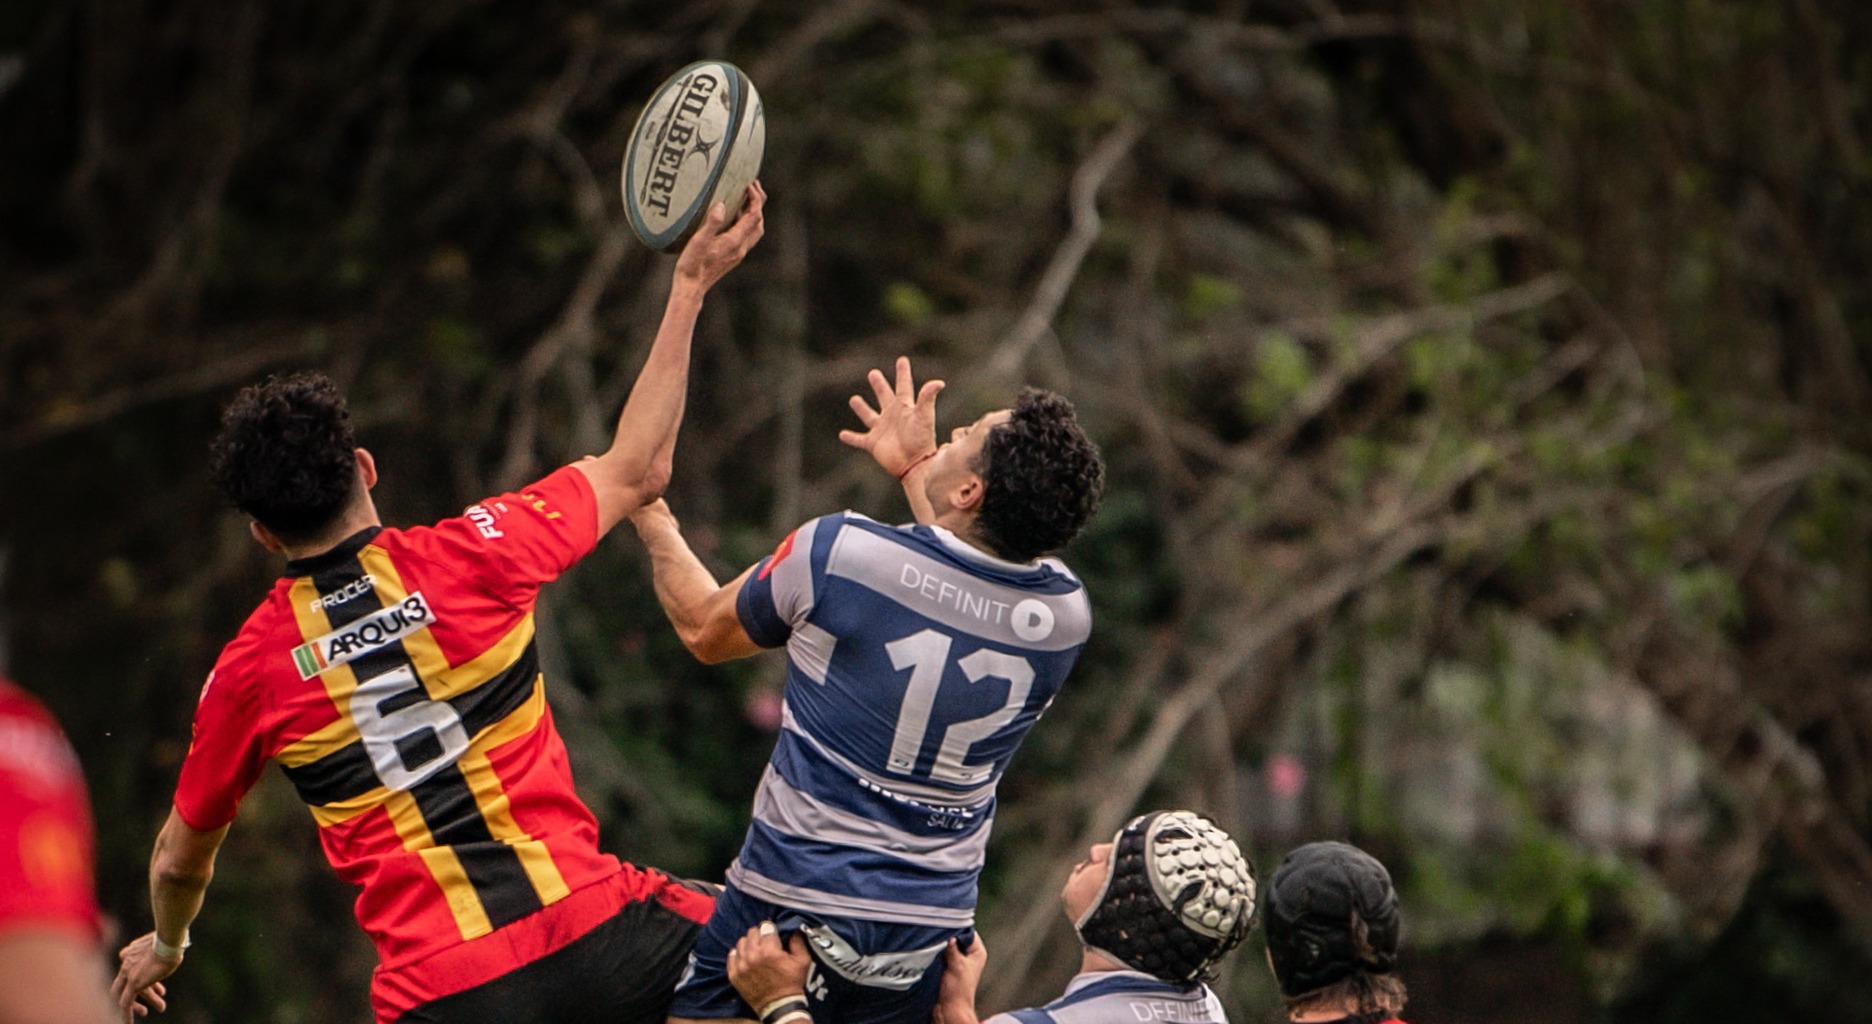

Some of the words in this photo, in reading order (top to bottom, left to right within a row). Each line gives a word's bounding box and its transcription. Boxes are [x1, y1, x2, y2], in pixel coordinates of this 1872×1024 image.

[649, 73, 718, 218] GILBERT
[310, 574, 378, 614] PROCER
[328, 596, 427, 662] ARQUI3
[350, 664, 470, 792] 6
[885, 628, 1036, 781] 12
